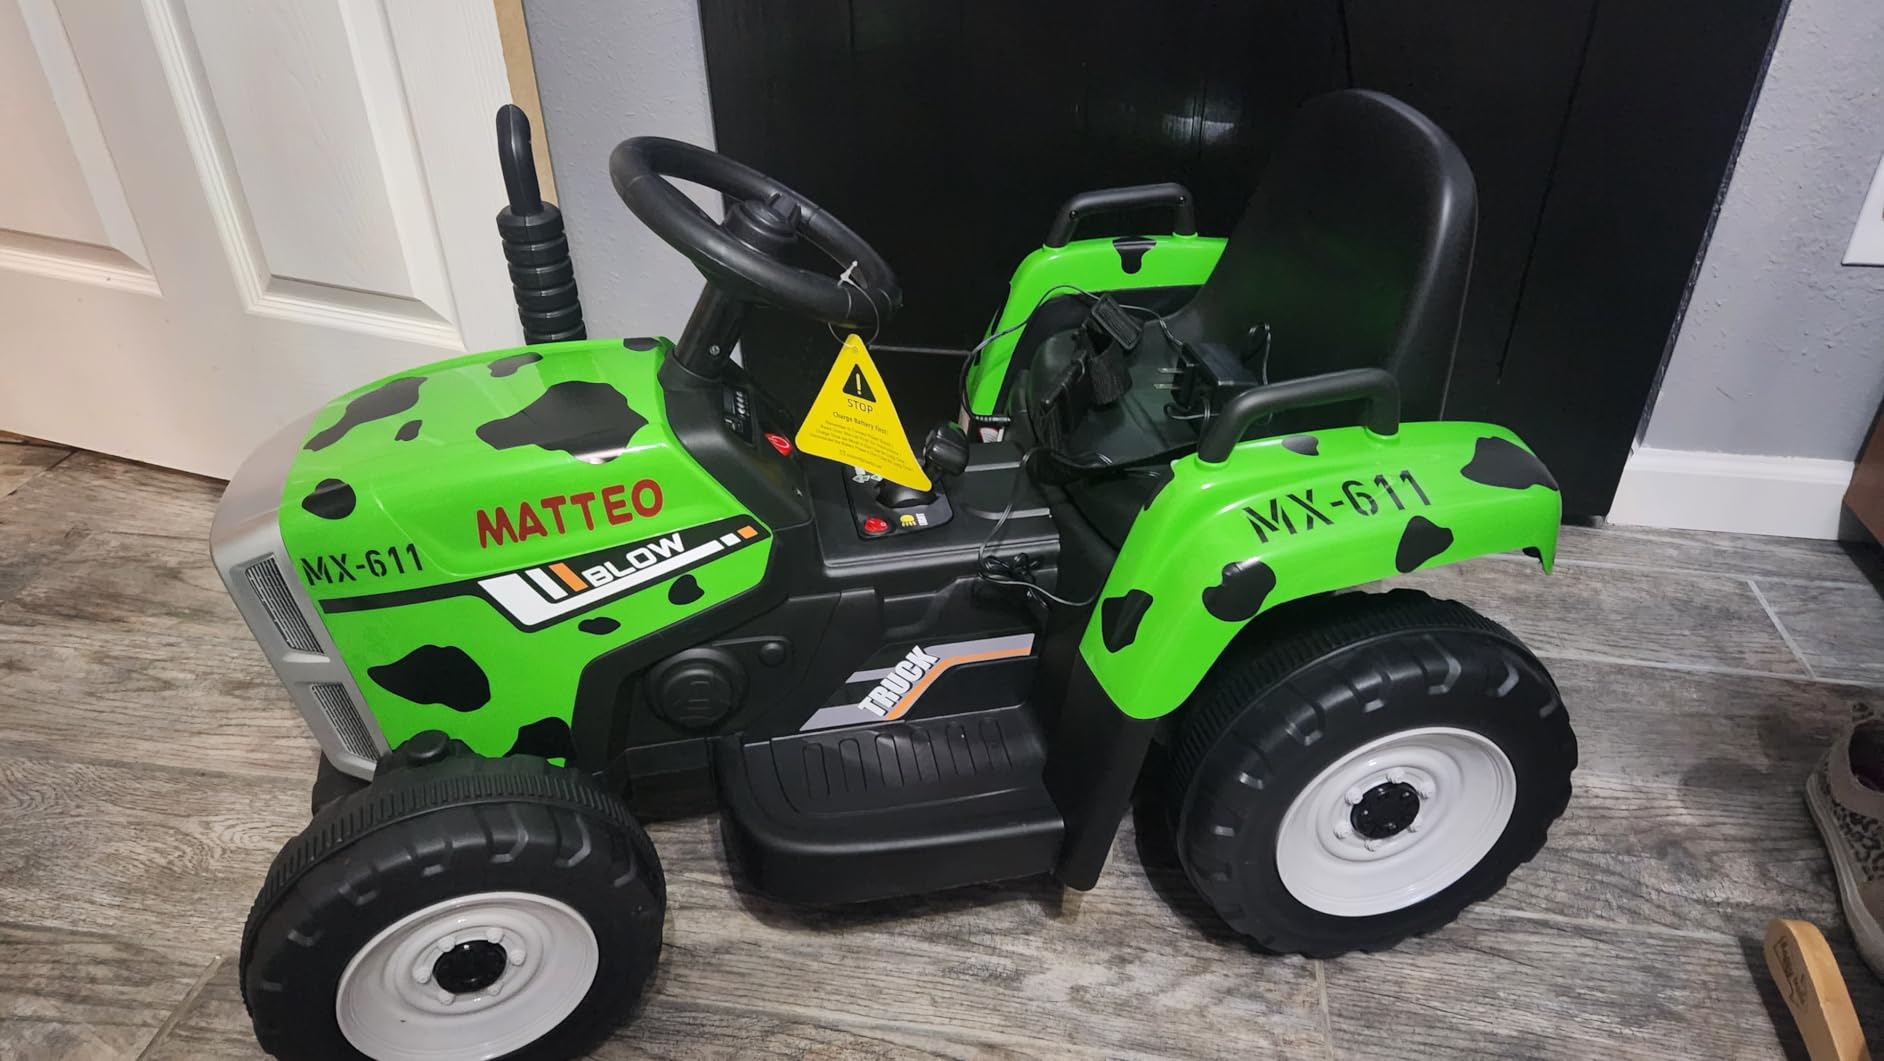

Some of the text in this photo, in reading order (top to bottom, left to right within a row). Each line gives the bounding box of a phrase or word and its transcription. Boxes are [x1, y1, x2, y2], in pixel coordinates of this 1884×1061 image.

[832, 411, 853, 423] Charge
[854, 417, 875, 431] Battery
[847, 398, 874, 414] STOP
[476, 478, 663, 549] MATTEO
[1243, 470, 1431, 544] MX-611
[301, 543, 424, 587] MX-611
[589, 532, 685, 588] BLOW
[857, 645, 938, 717] TRUCK
